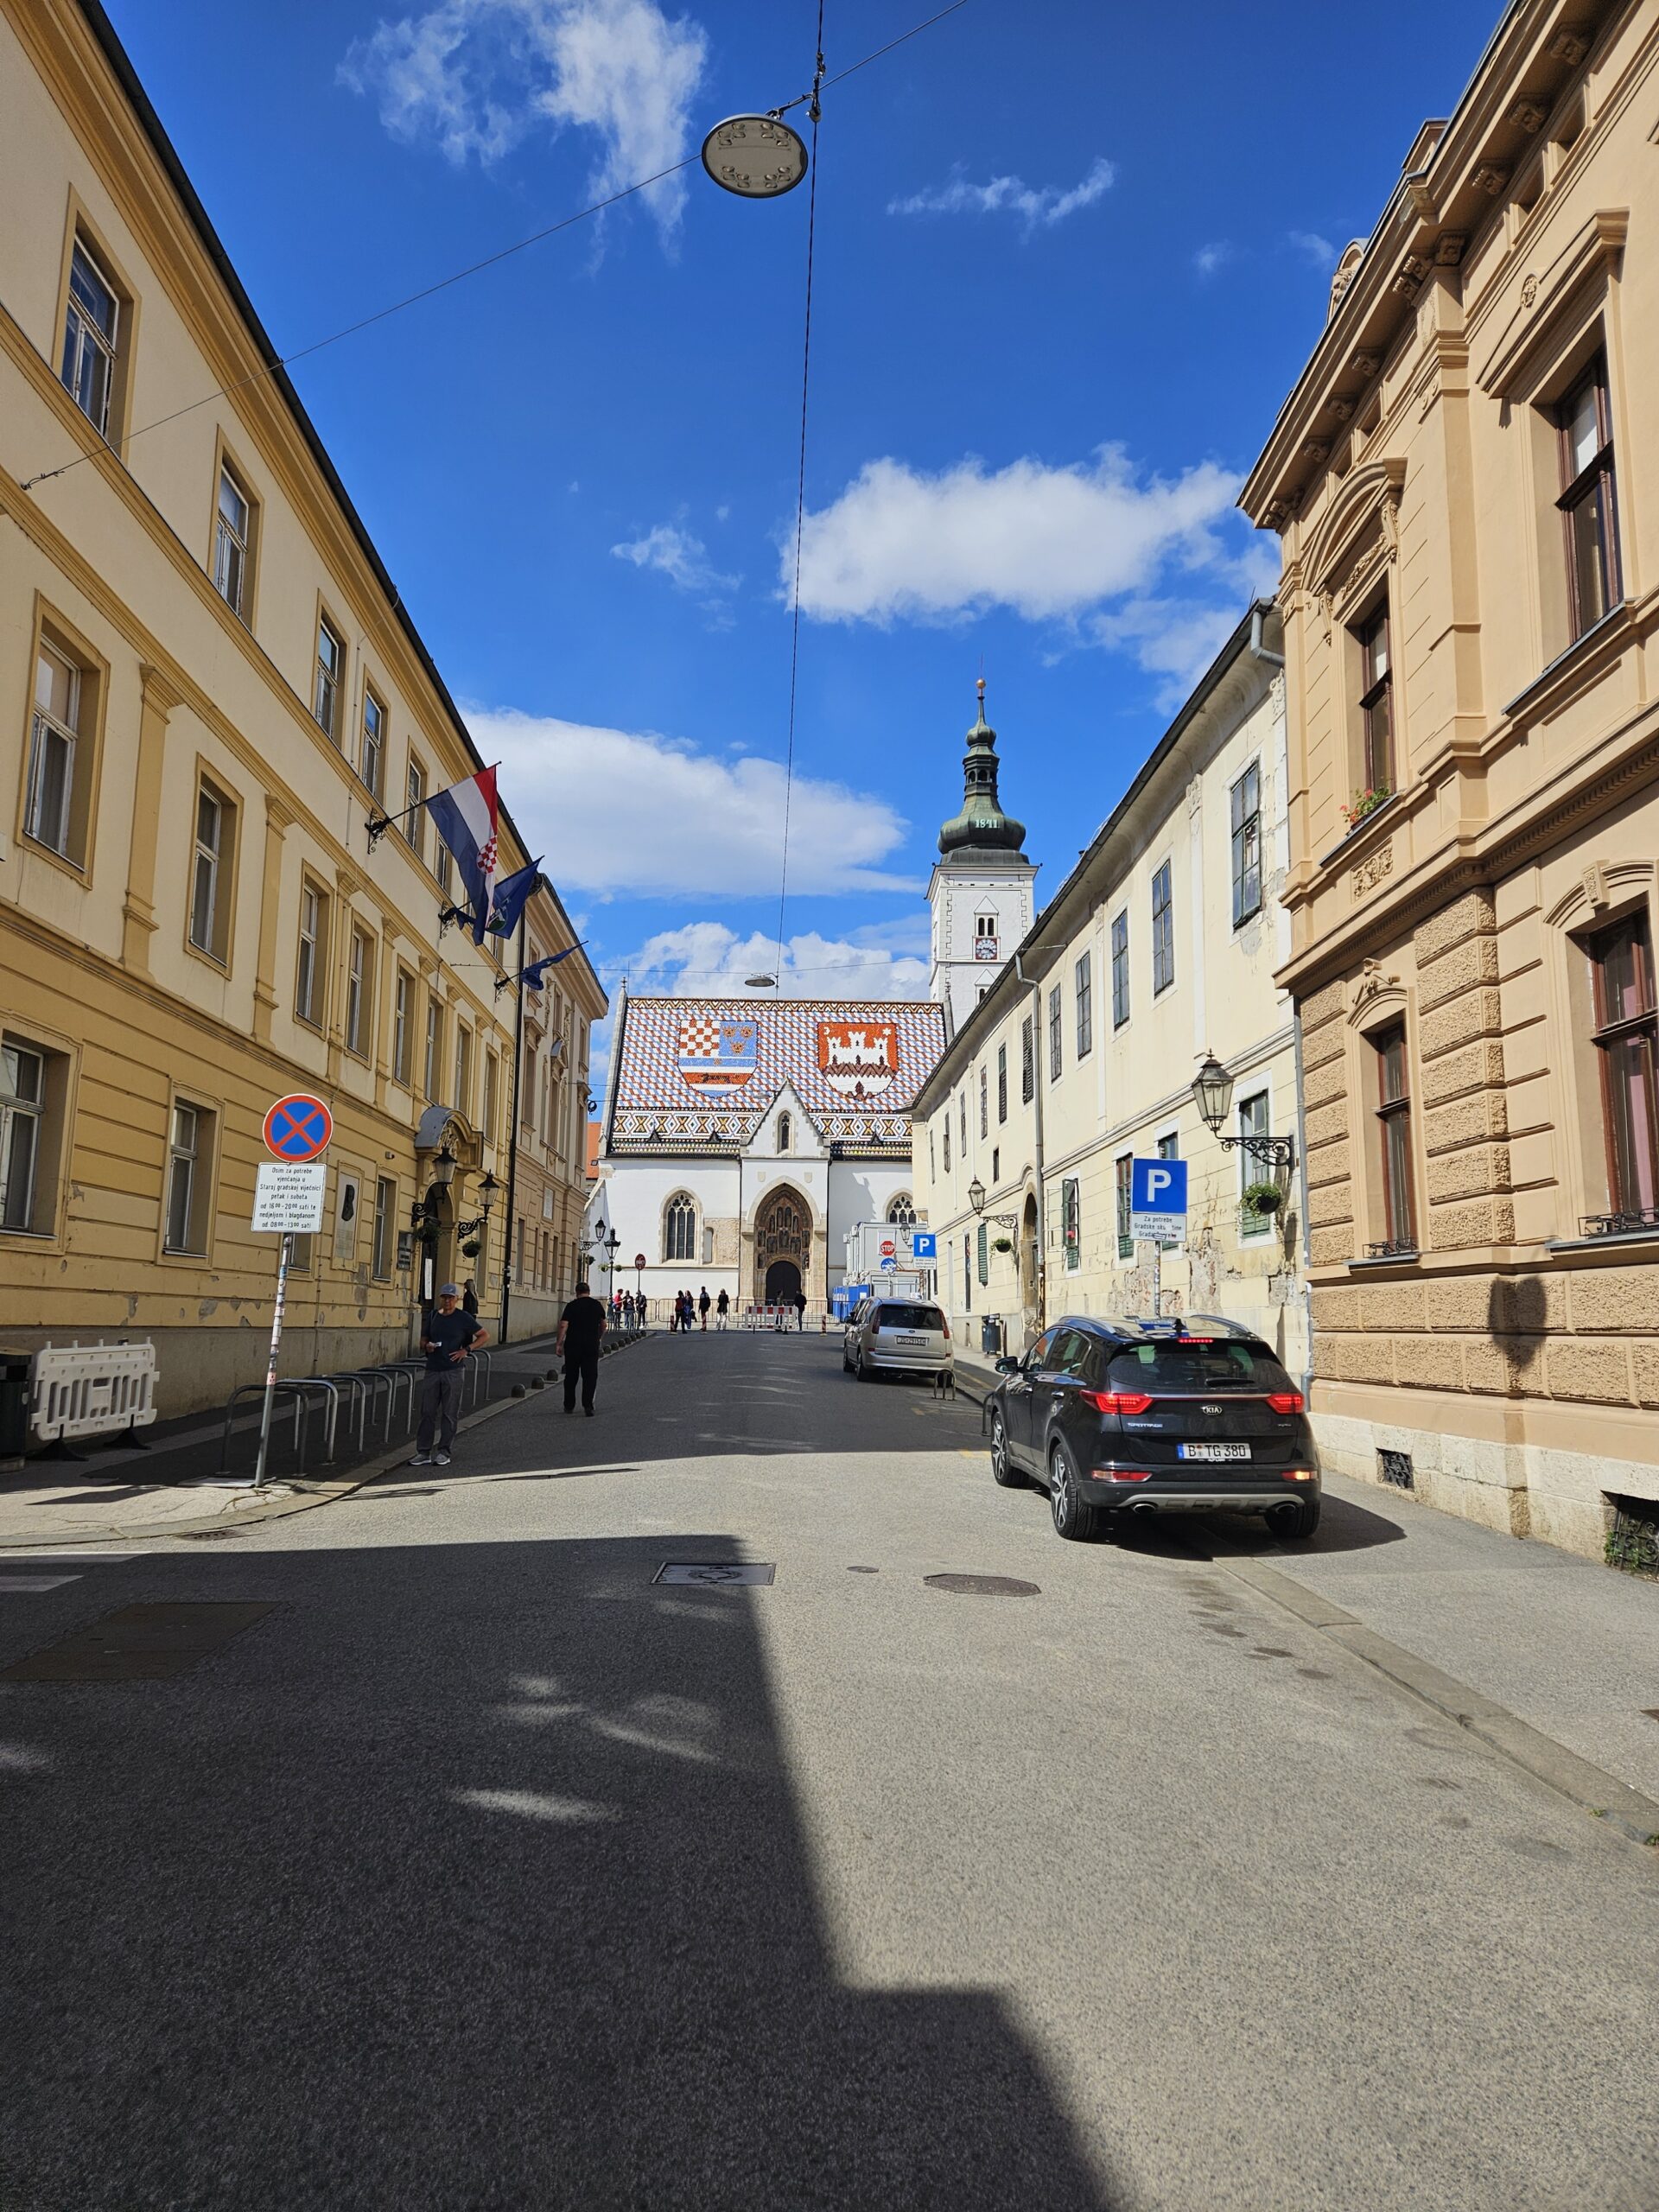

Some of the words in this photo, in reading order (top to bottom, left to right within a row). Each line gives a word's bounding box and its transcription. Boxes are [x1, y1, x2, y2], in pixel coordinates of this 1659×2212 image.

[1147, 1169, 1172, 1202] P
[919, 1238, 930, 1253] P
[1189, 1445, 1196, 1457] B
[1205, 1445, 1221, 1457] TG
[1224, 1445, 1246, 1457] 380
